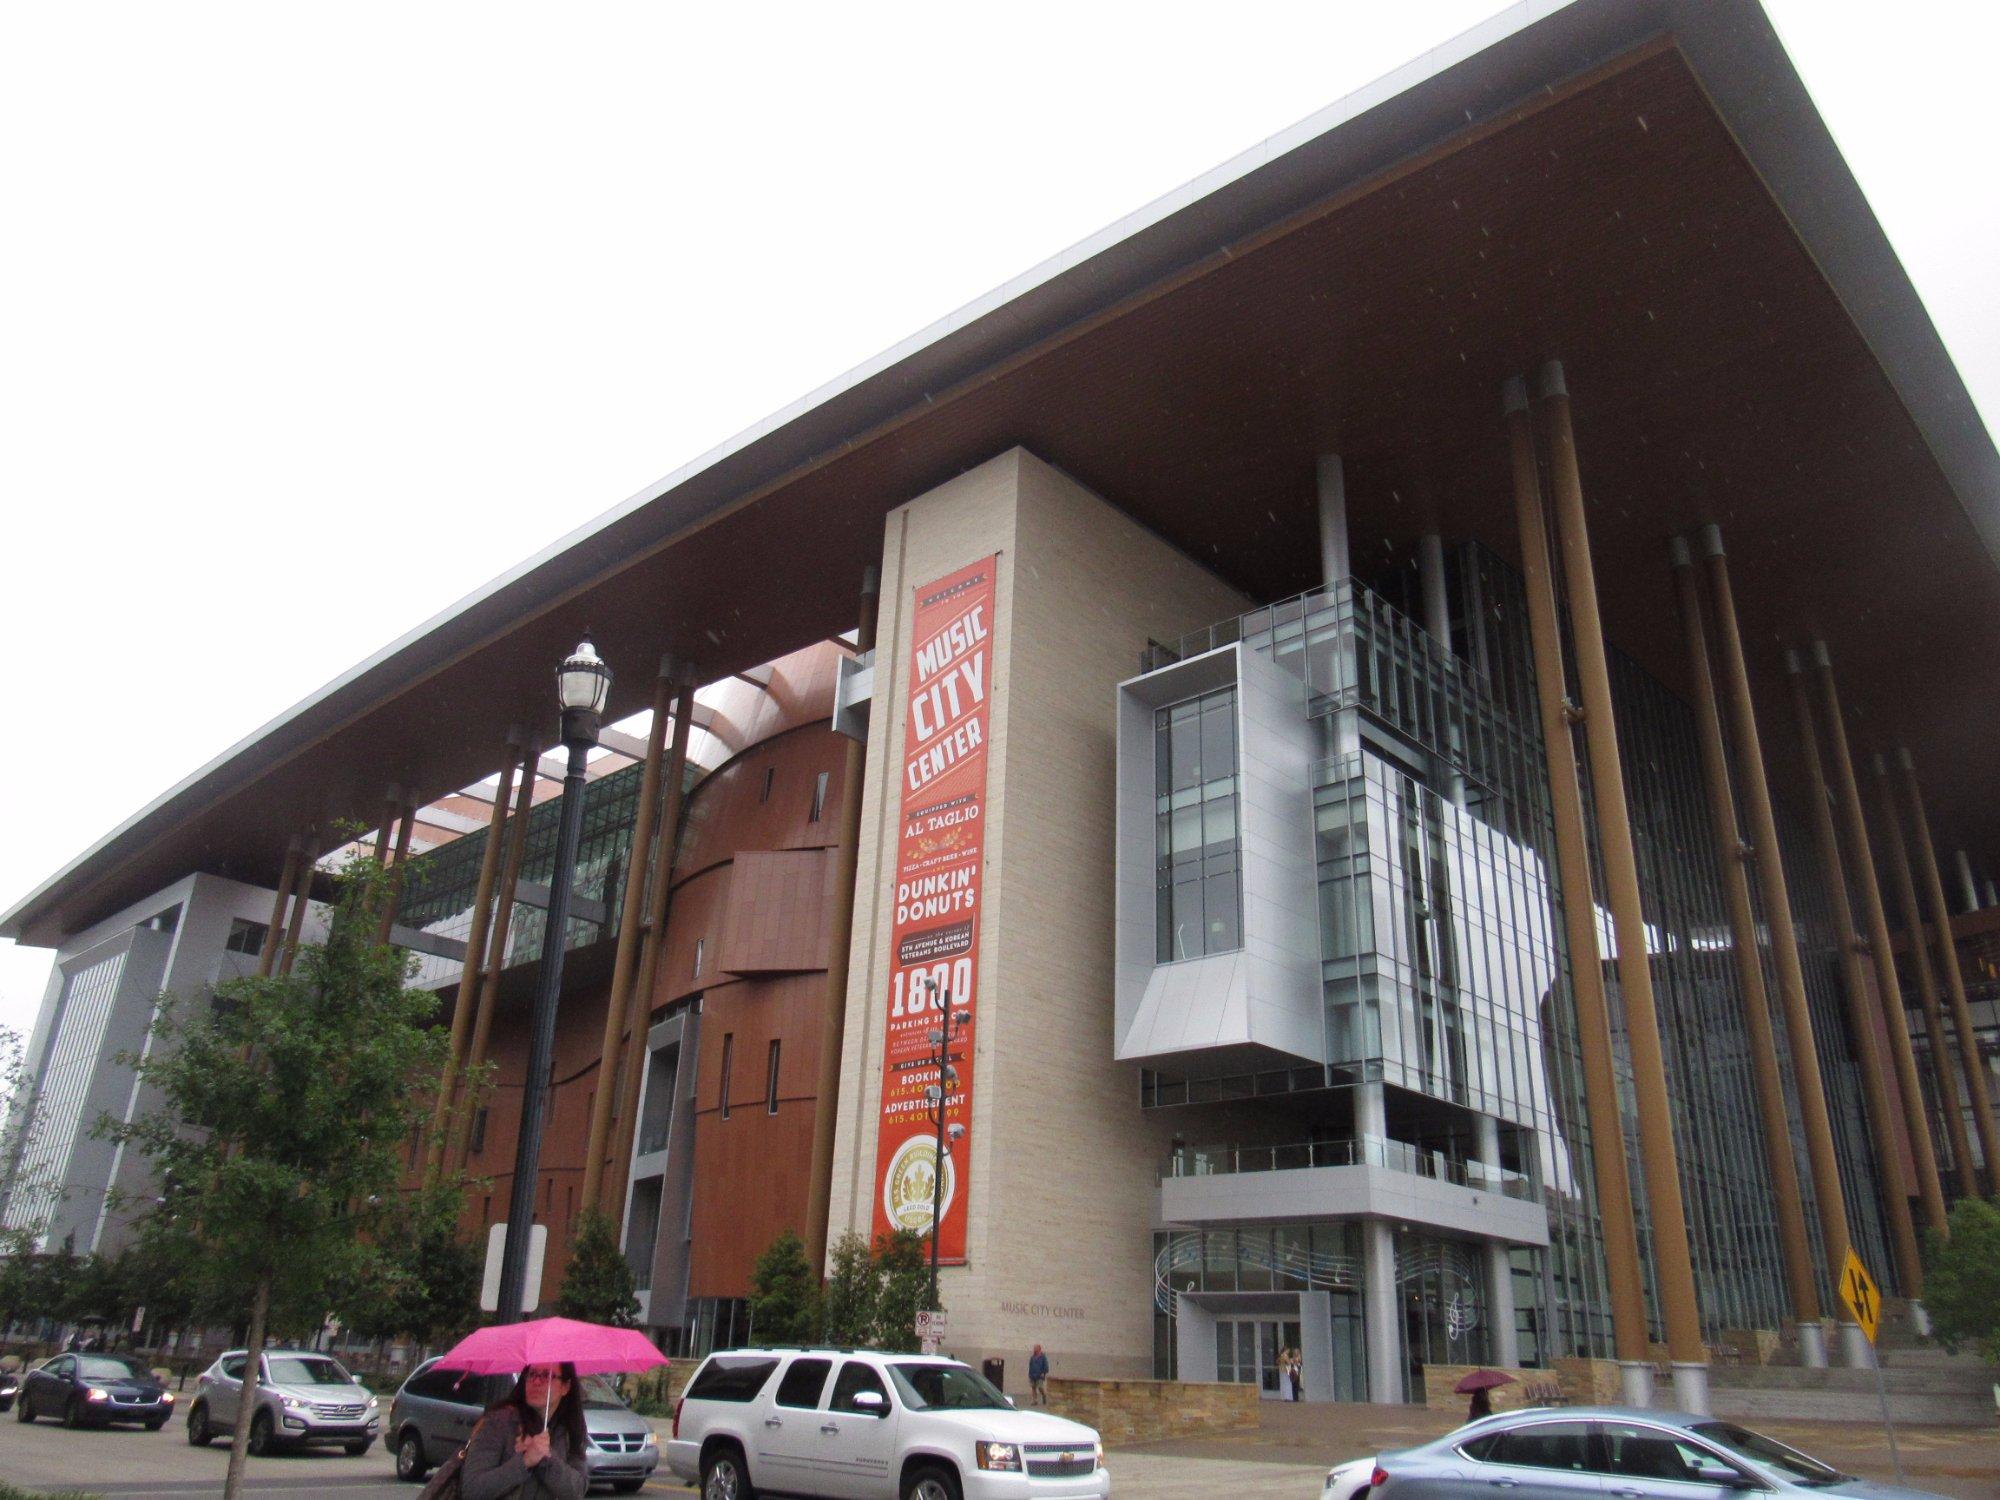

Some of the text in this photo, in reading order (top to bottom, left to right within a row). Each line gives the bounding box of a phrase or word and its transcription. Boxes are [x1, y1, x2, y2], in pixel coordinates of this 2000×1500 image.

[916, 605, 987, 682] MUSIC
[912, 650, 983, 742] CITY
[908, 717, 982, 790] CENTER
[905, 805, 979, 838] AL TAGLIO
[898, 865, 976, 903] DUNKIN'
[903, 864, 919, 873] PIZZA
[897, 888, 975, 925] DONUTS
[901, 940, 969, 960] VETERANS BOULEVARD
[914, 939, 938, 950] AVENUE
[944, 932, 970, 944] KOREAN
[892, 957, 972, 1018] 1800
[890, 1017, 930, 1031] PARKING
[901, 1069, 943, 1085] BOOKIN
[1001, 1302, 1085, 1319] MUSIC CITY CENTER
